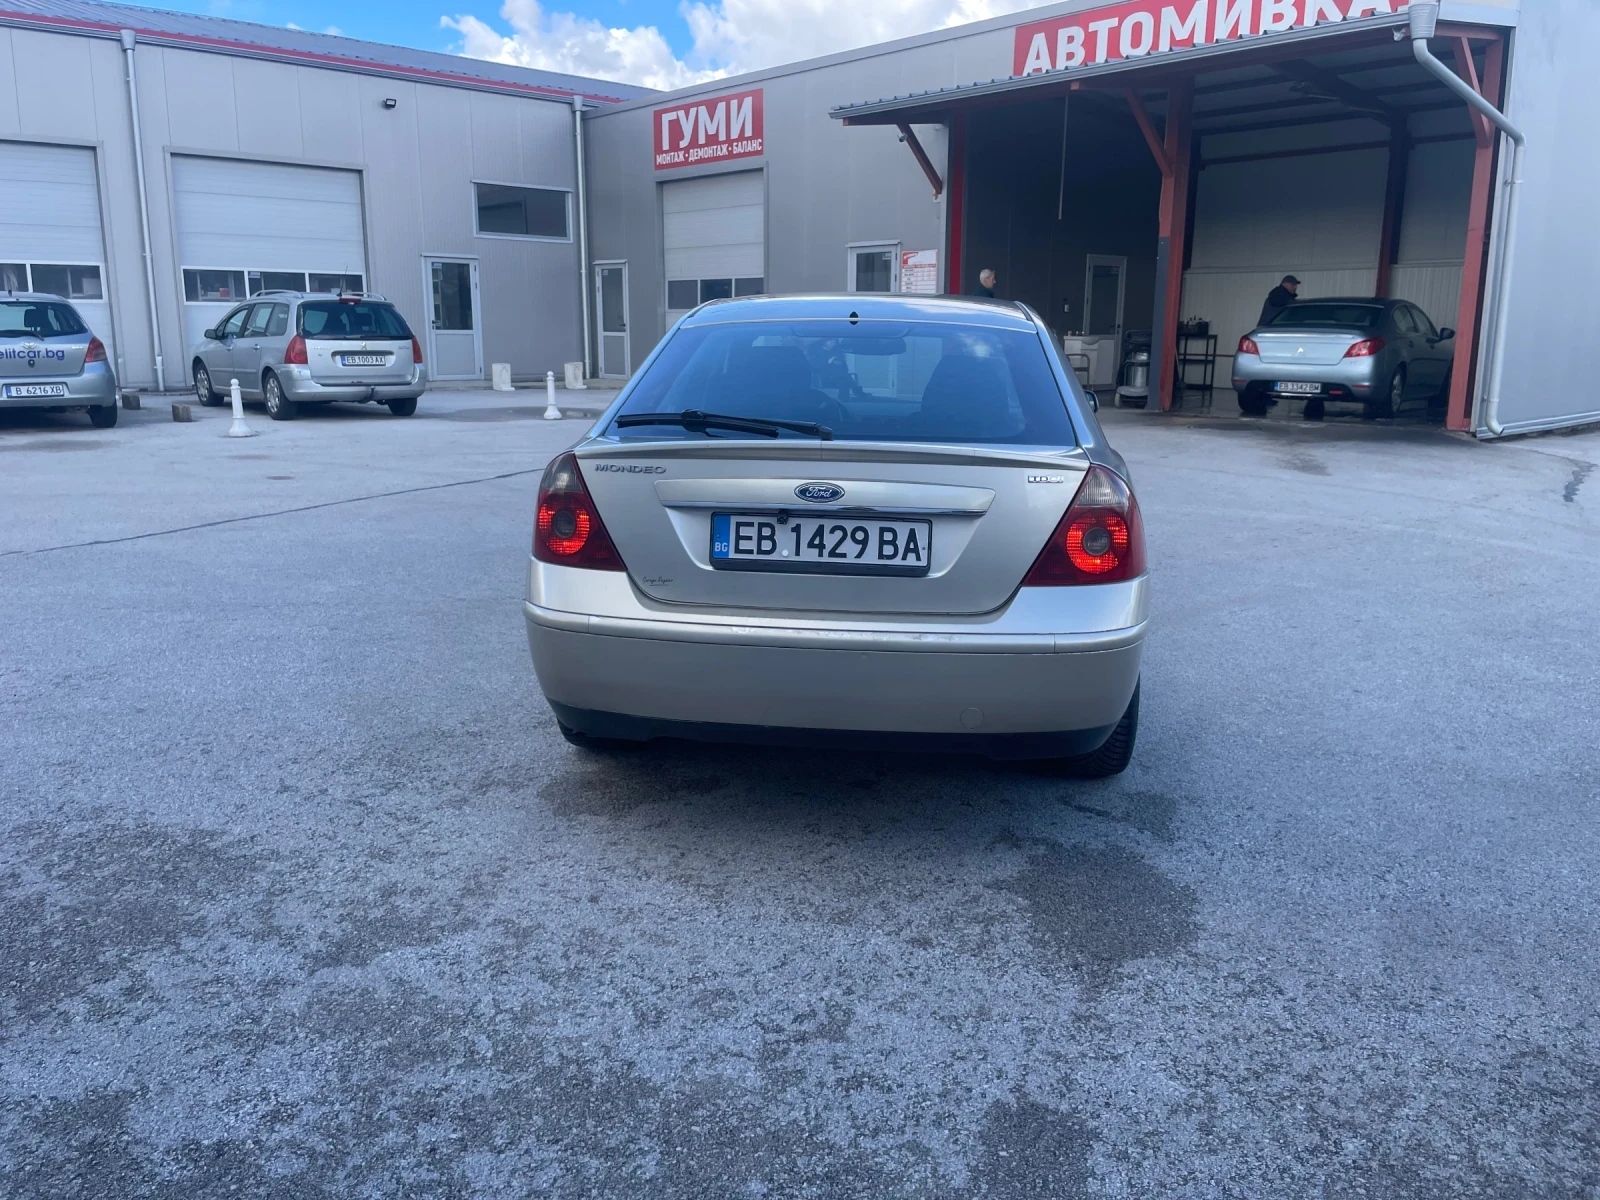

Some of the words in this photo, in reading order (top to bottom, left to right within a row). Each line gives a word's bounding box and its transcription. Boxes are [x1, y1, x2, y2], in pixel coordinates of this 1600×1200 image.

[661, 96, 753, 151] ГУМИ
[656, 151, 685, 165] МОНТАЖ
[688, 143, 729, 162] ДЕМОНТАЖ
[732, 138, 763, 154] БАЛАНС
[0, 348, 65, 361] elitcar.bg
[26, 386, 49, 395] 6216
[595, 463, 667, 474] MONDEO
[805, 486, 833, 498] Ford
[714, 542, 728, 552] BG
[734, 521, 778, 556] EB
[790, 523, 870, 559] 1429
[877, 526, 922, 562] BA
